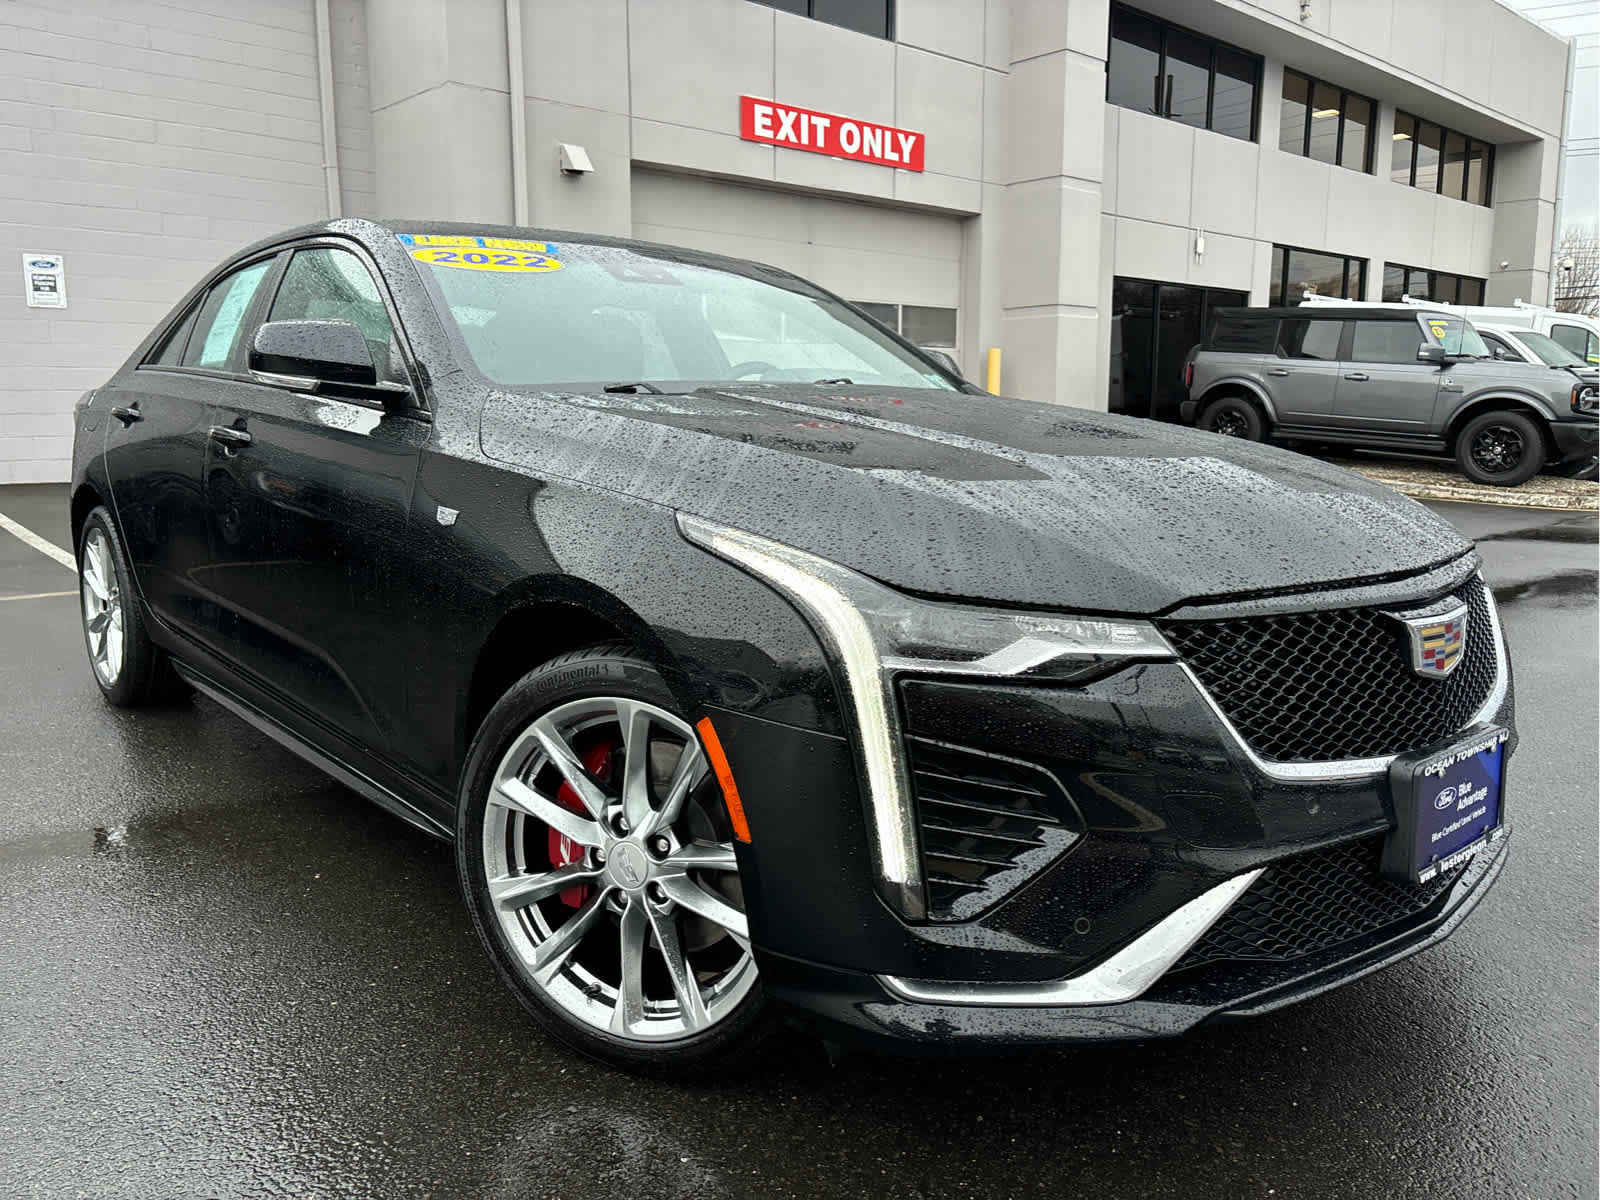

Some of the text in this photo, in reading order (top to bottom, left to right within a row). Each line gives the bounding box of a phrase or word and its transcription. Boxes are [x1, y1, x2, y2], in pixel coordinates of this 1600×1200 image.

[753, 103, 916, 164] EXIT ONLY
[432, 251, 549, 268] 2022
[536, 664, 600, 693] Continental
[1424, 730, 1510, 777] OCEAN TOWNSHIP NJ
[1437, 789, 1455, 807] Ford
[1457, 786, 1488, 811] Advantage
[1458, 782, 1472, 797] Blue
[1431, 832, 1442, 843] Blue
